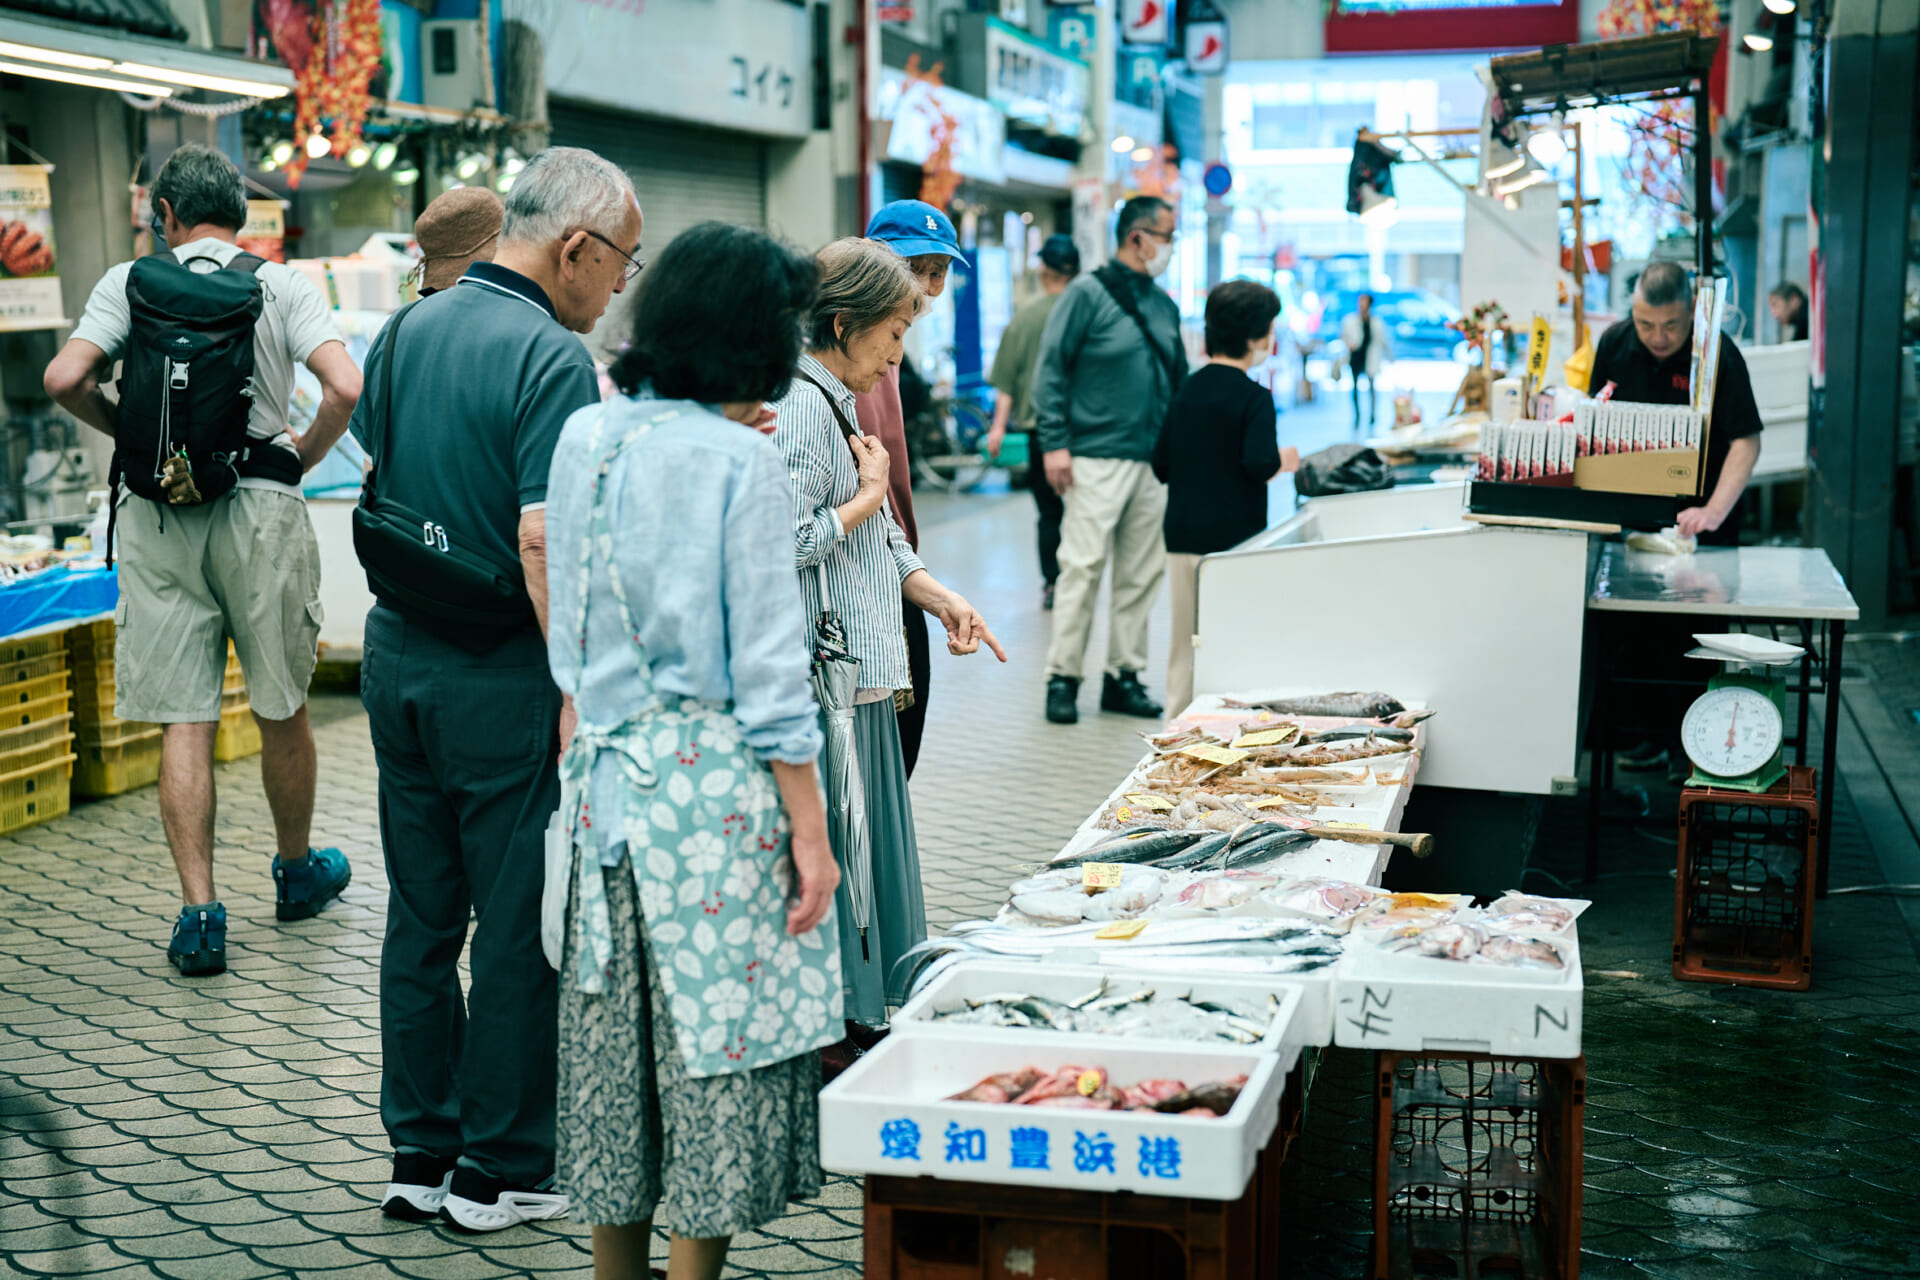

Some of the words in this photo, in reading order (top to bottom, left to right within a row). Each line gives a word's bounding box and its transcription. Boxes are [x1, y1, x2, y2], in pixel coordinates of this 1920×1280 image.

[730, 56, 794, 109] コイケ
[926, 215, 938, 230] LA
